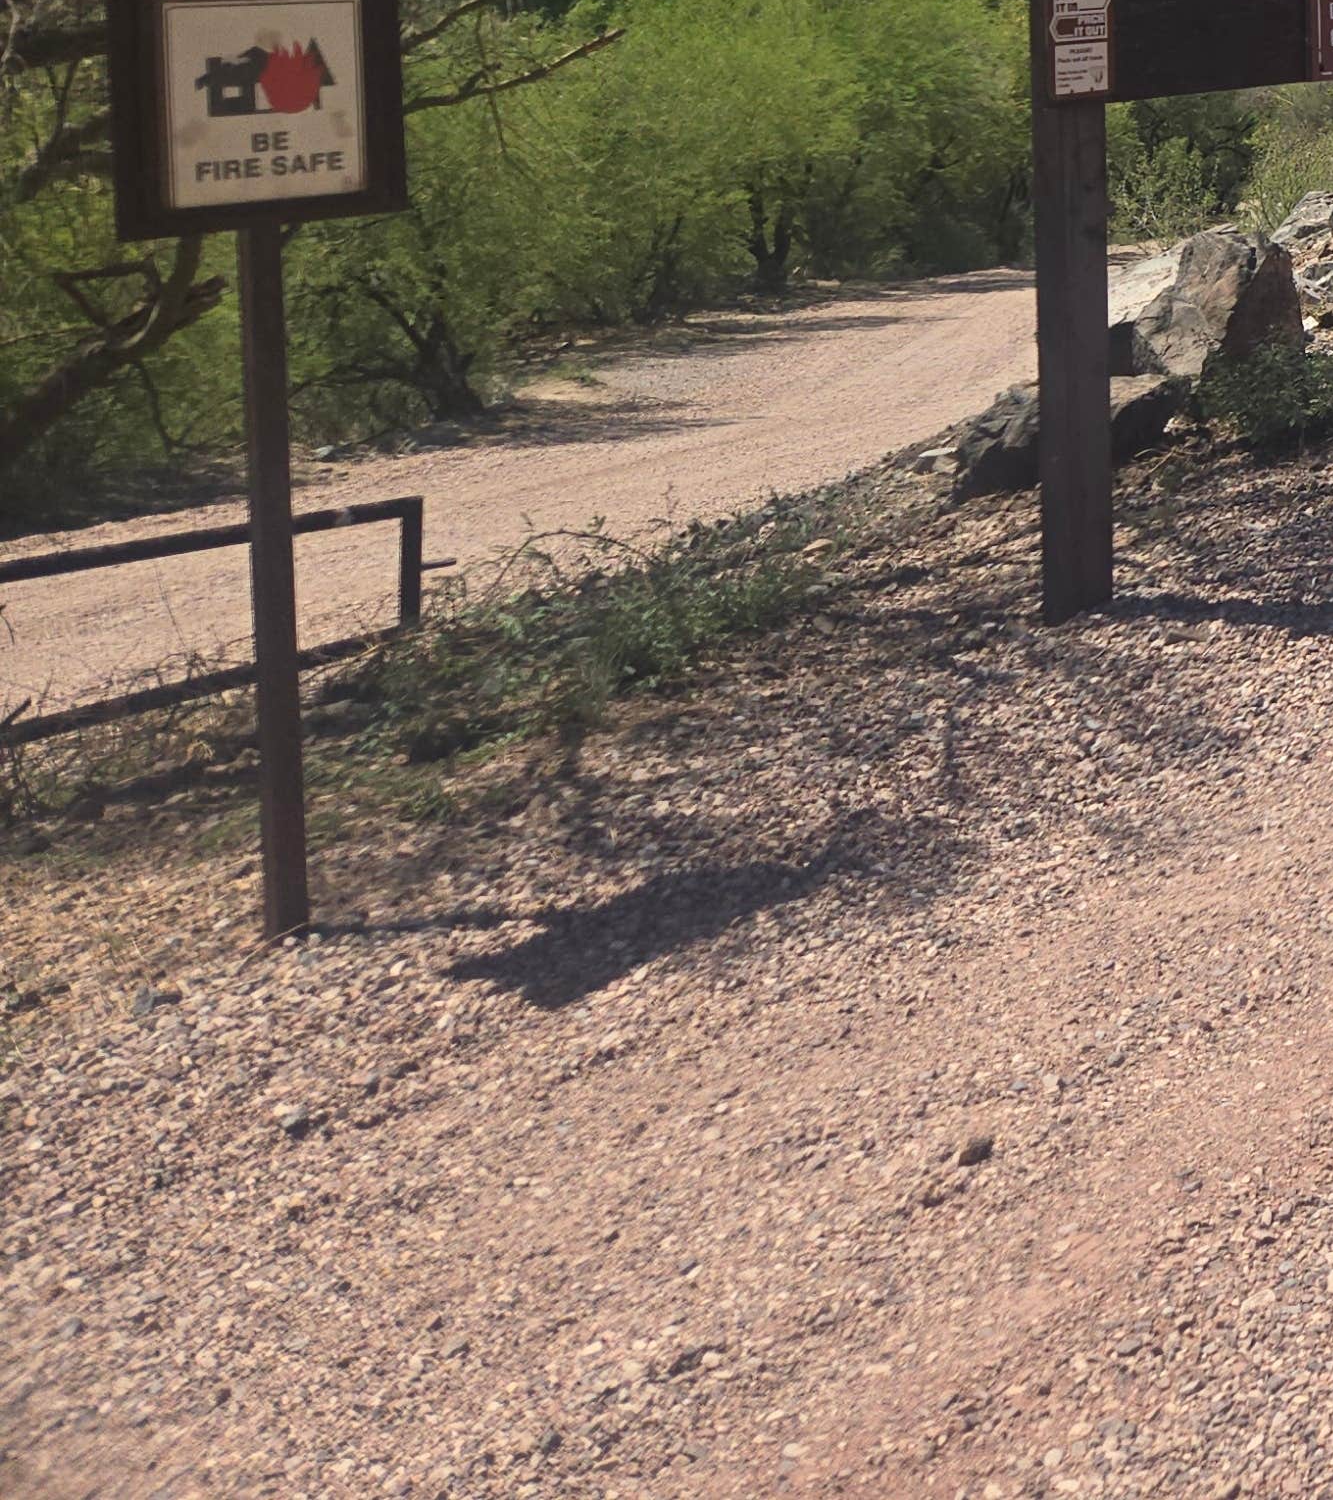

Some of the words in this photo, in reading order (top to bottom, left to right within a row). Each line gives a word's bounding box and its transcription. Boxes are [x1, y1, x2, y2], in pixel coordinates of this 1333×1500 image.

[1084, 26, 1104, 36] OUT
[251, 131, 290, 153] BE
[195, 157, 263, 182] FIRE
[271, 151, 345, 176] SAFE
